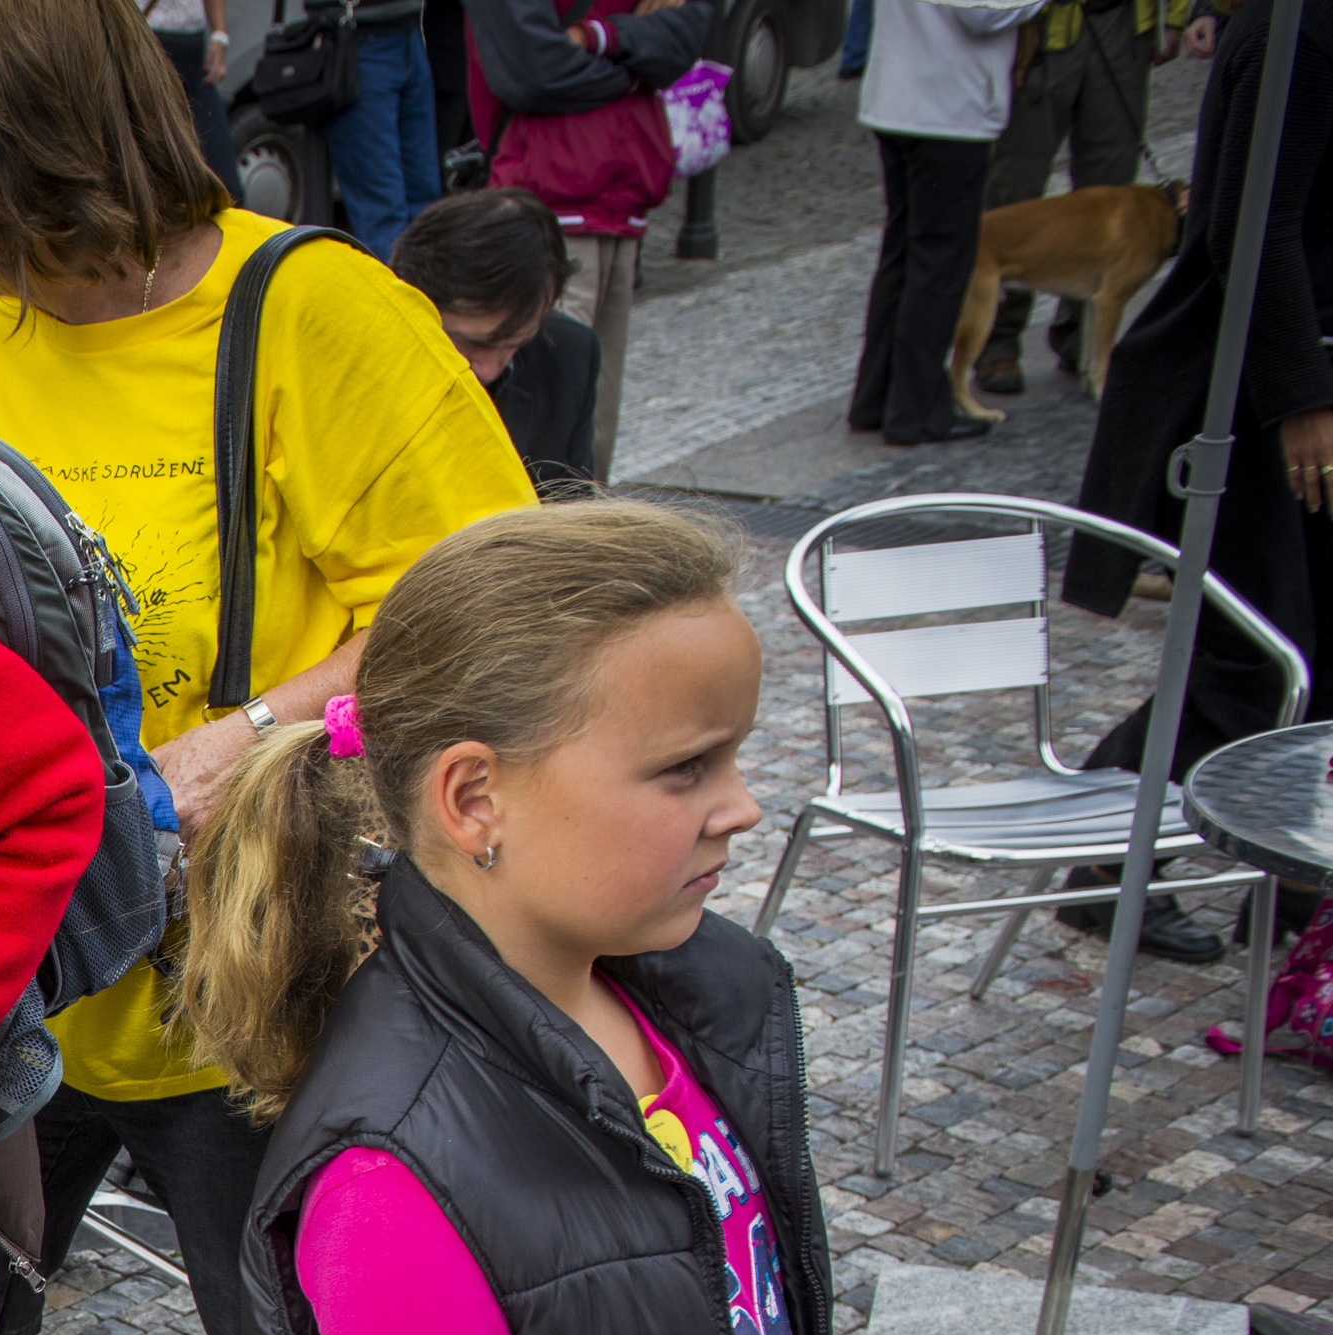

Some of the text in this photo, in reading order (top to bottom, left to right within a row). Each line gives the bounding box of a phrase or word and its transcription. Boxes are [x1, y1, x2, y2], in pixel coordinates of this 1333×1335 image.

[30, 457, 206, 482] ANSKÉ SDRUŽENÍ
[141, 668, 192, 711] EM
